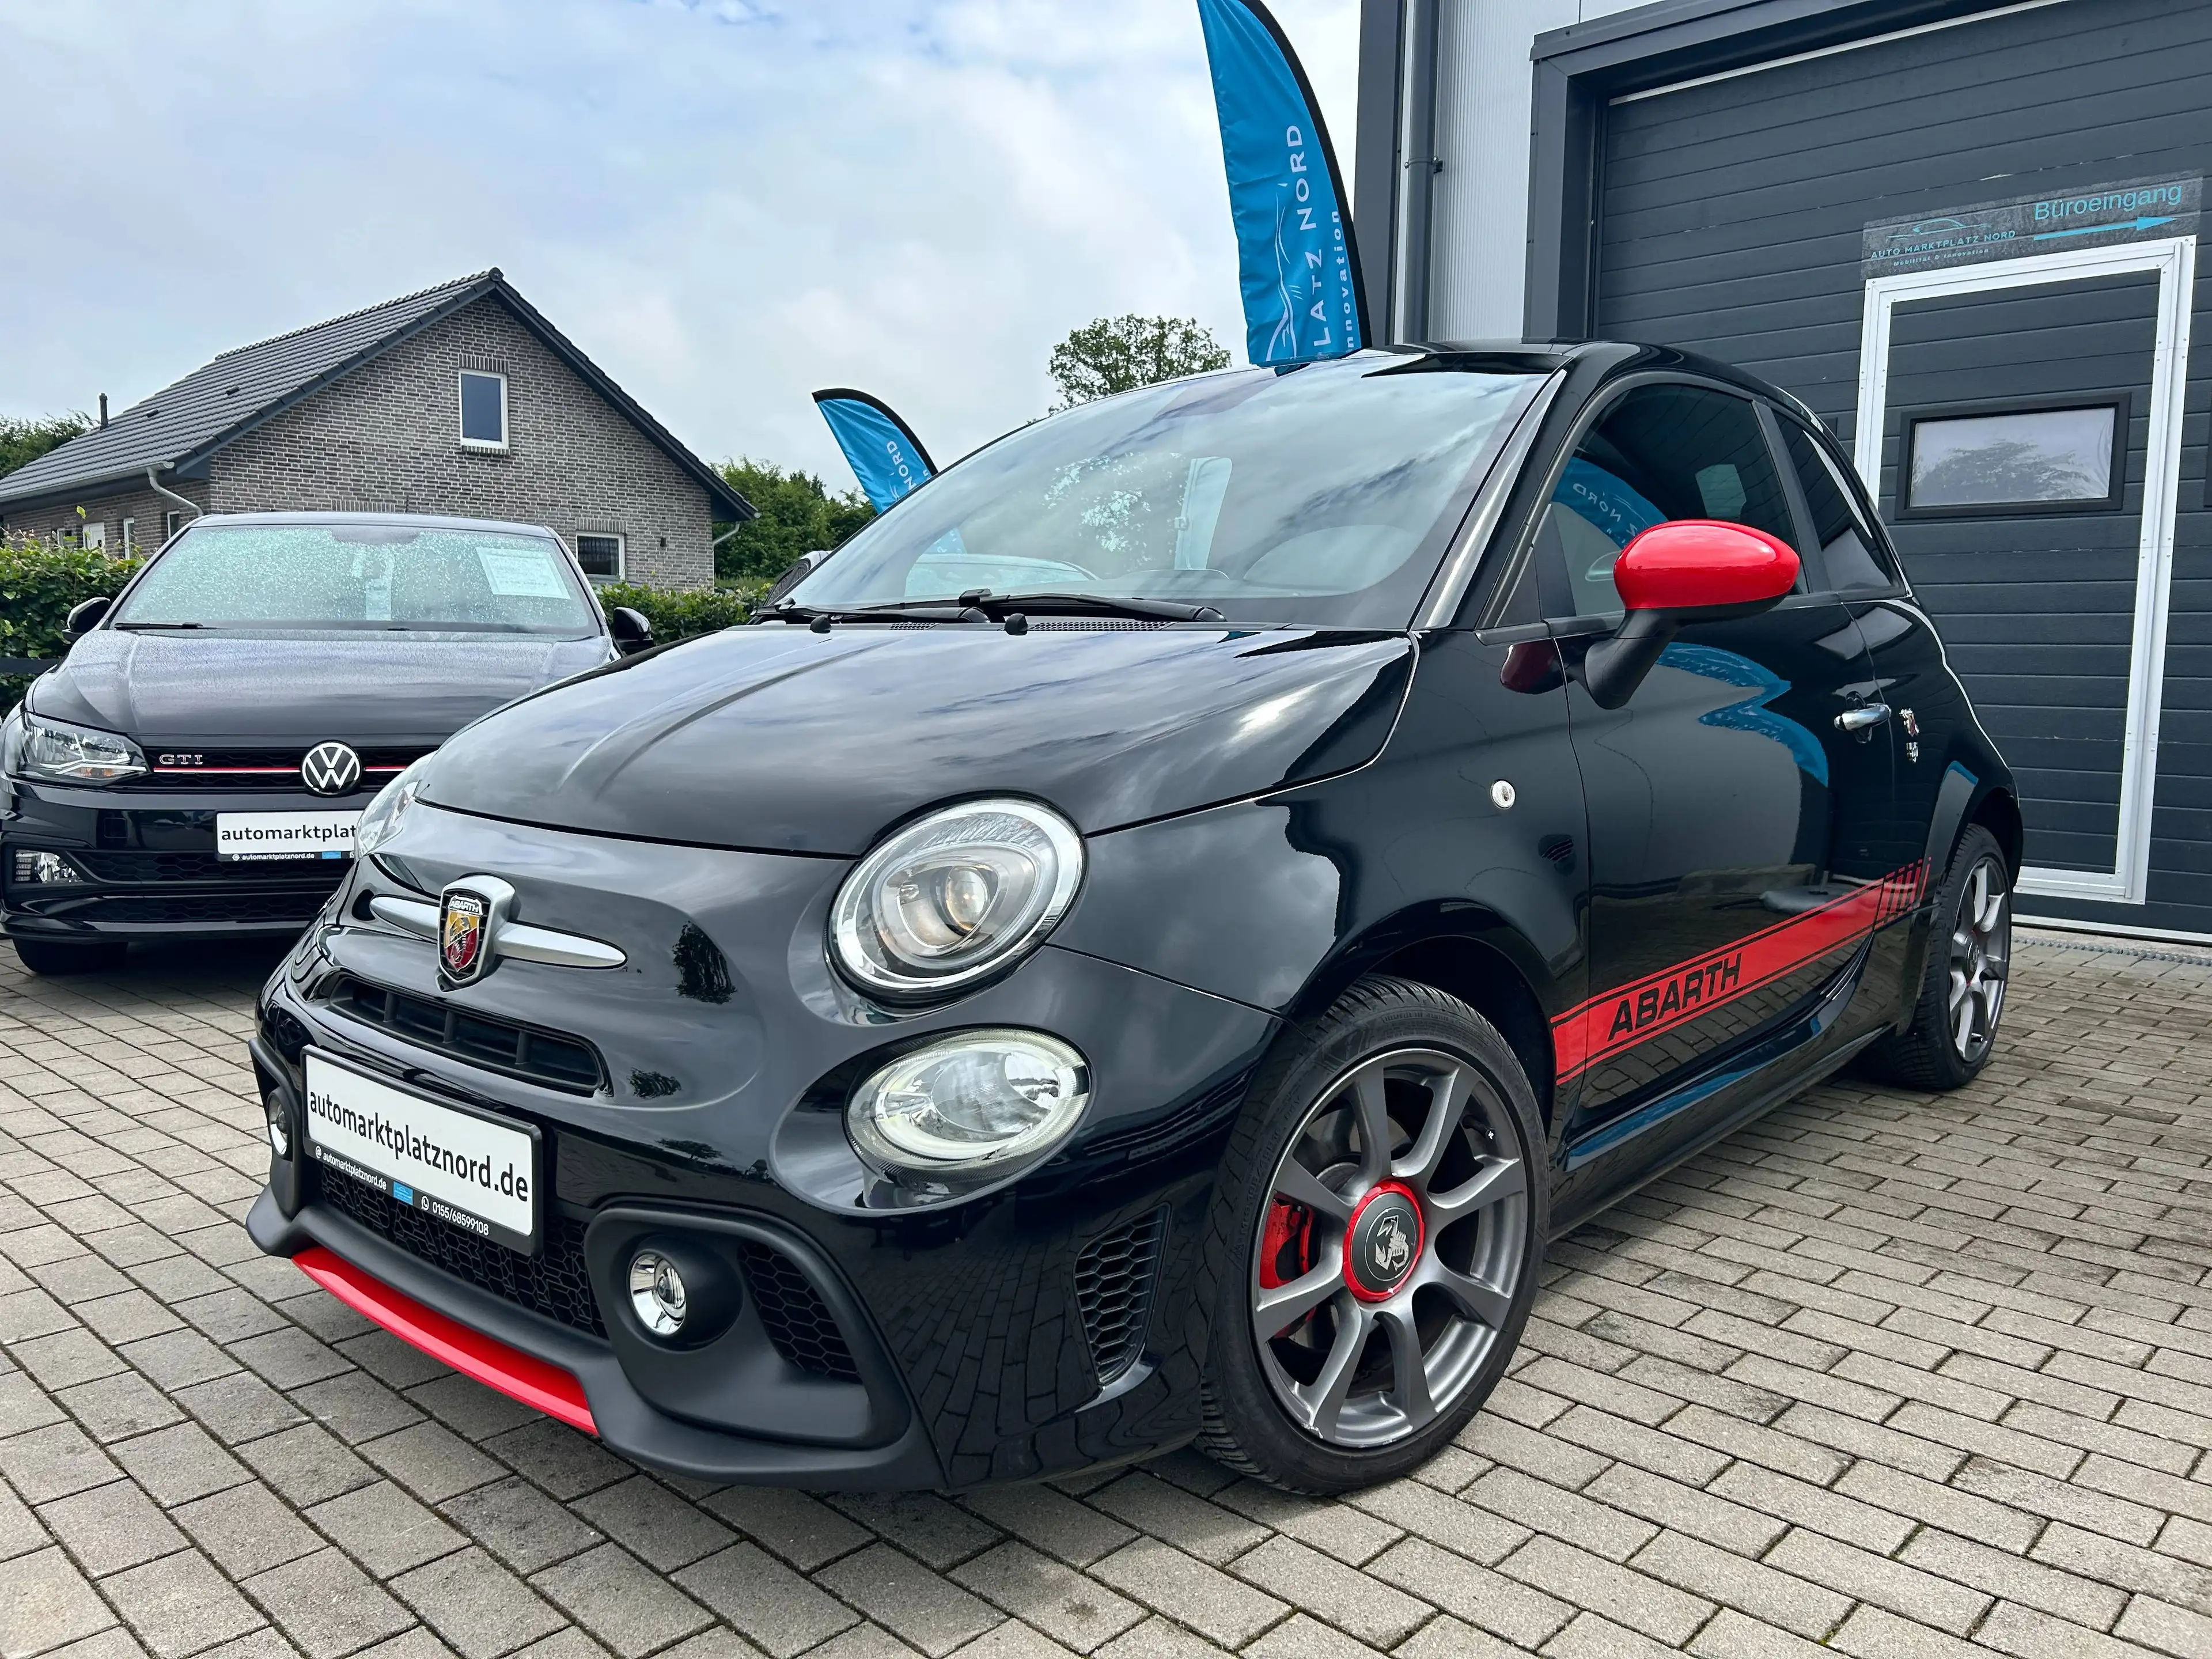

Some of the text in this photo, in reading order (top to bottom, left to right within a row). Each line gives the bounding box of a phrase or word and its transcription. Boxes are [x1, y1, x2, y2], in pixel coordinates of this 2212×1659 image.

[1286, 124, 1317, 231] NORD
[2035, 185, 2182, 220] Büroeingang
[1871, 230, 2016, 259] AUTO MARKTPLATZ NORD
[887, 441, 916, 490] NORD
[159, 754, 203, 765] GTI
[450, 900, 479, 913] ABARTH
[1608, 953, 1742, 1041] ABARTH
[310, 1091, 528, 1202] automarktplatznord.de
[323, 1152, 387, 1191] automarktplatznord.de
[432, 1201, 490, 1236] 0155/68599108
